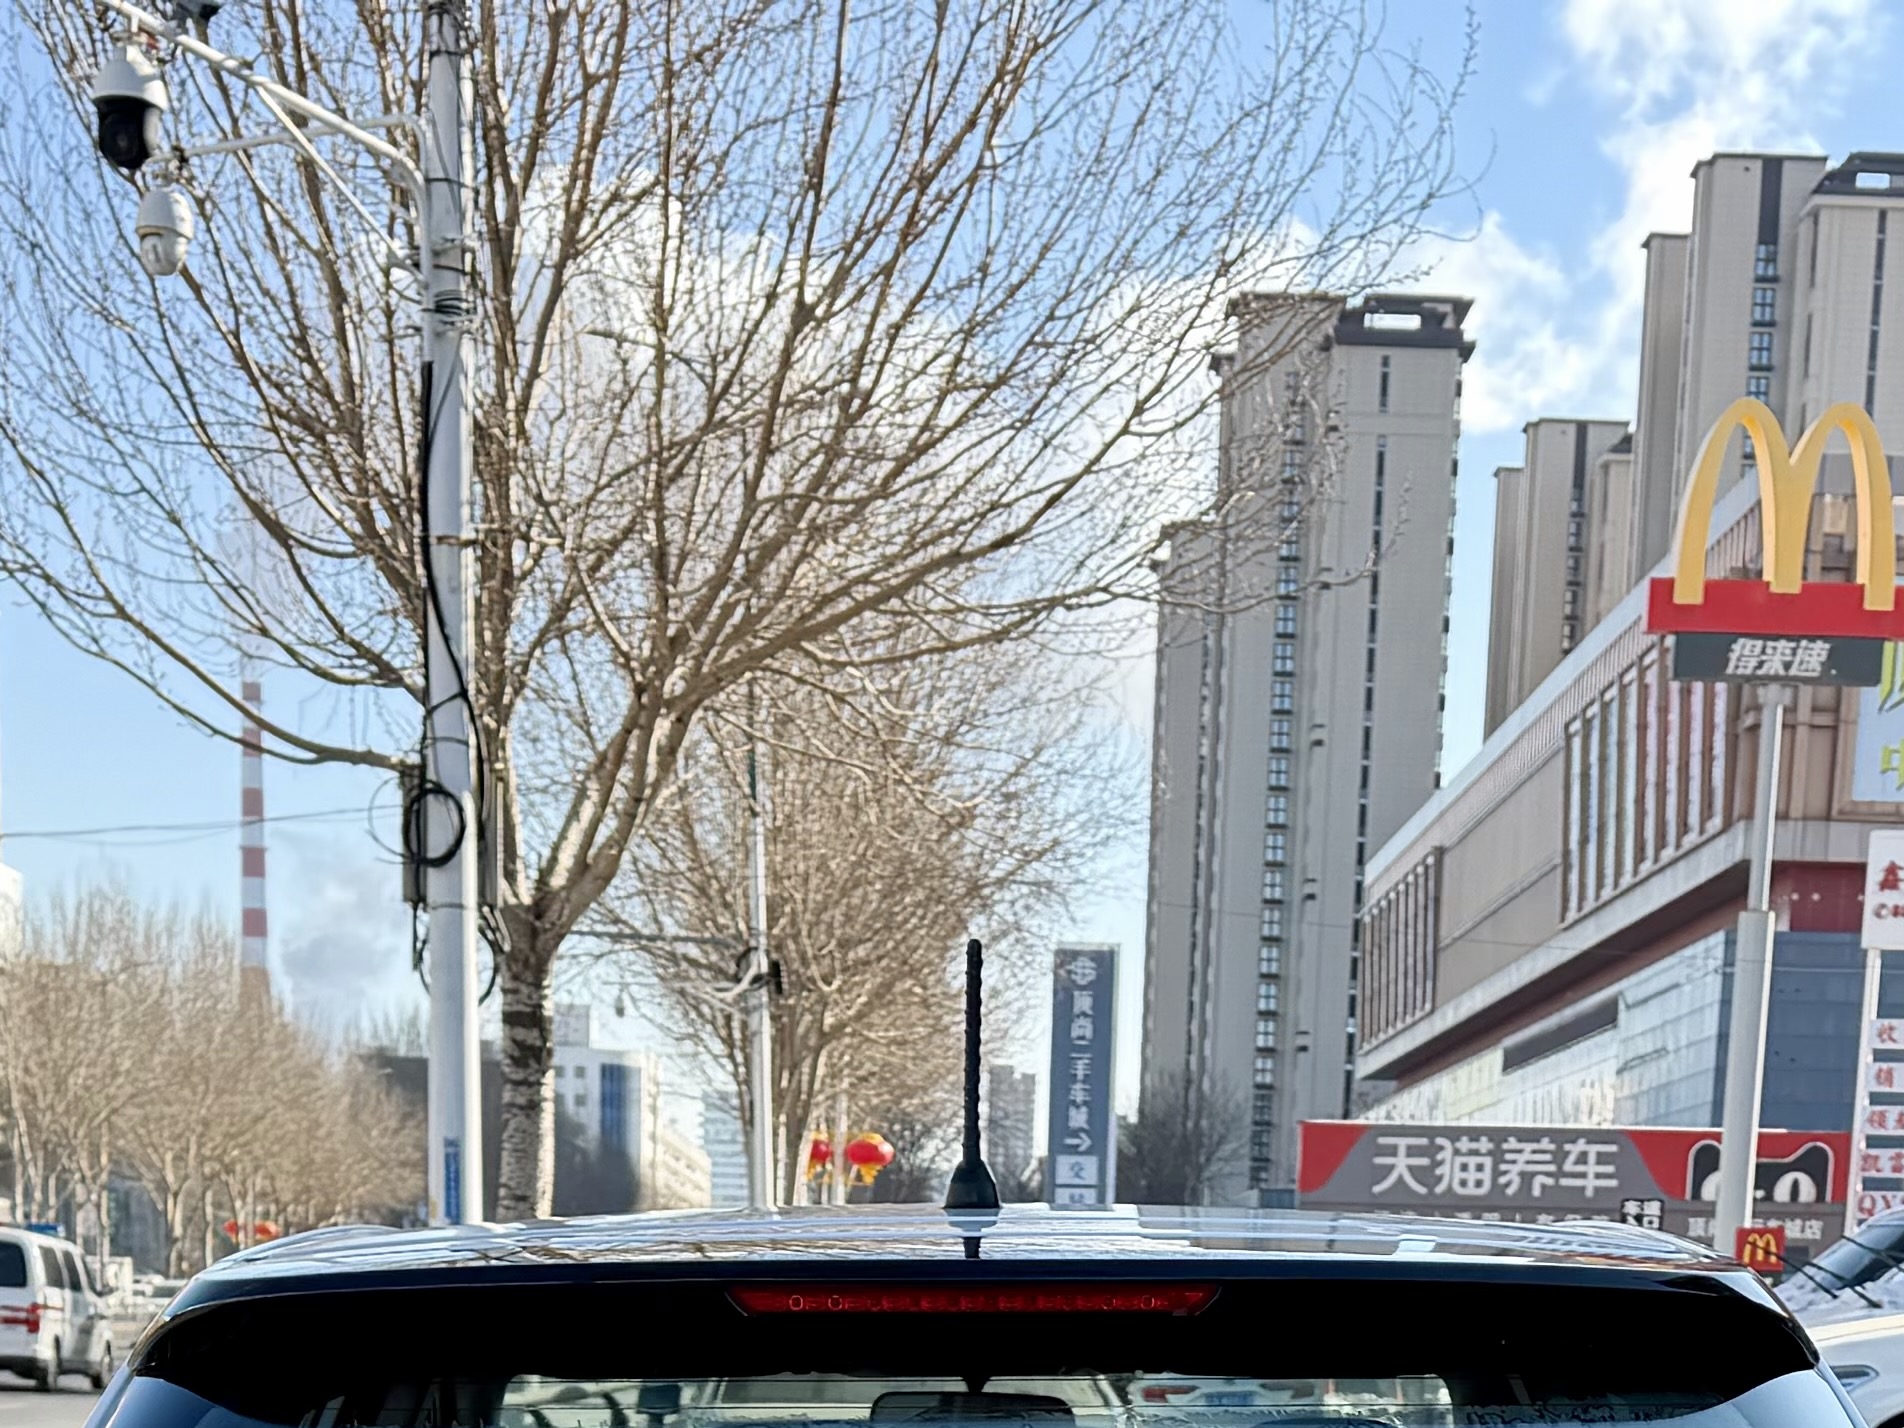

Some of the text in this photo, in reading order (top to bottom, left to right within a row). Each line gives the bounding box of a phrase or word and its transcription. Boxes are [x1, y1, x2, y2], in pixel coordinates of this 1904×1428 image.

[1725, 637, 1832, 678] 得来速
[1371, 1135, 1620, 1198] 天猫养车
